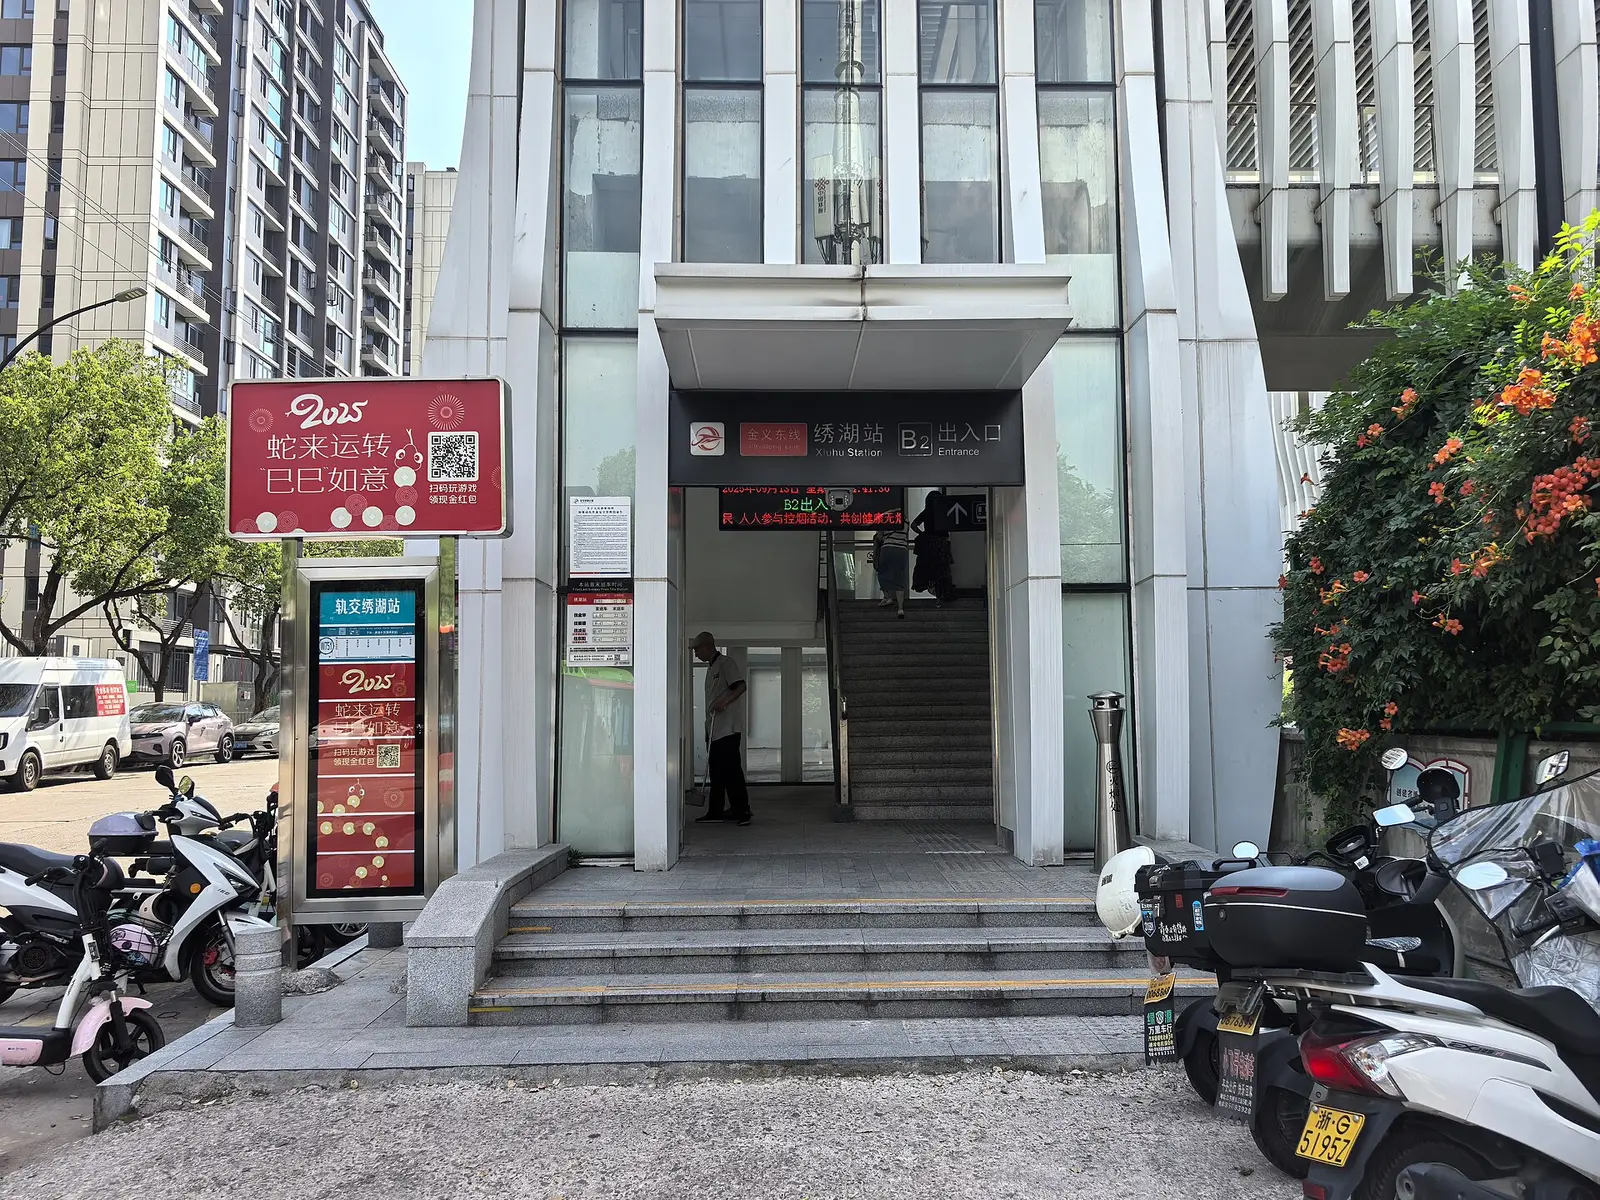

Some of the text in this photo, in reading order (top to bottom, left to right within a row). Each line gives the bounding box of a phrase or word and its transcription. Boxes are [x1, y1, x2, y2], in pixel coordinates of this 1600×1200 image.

[285, 393, 369, 430] 2025
[748, 428, 801, 441] 金义东线
[814, 423, 884, 444] 绣湖站
[901, 429, 930, 449] B2
[938, 423, 1001, 443] 出入口
[266, 433, 392, 460] 蛇来运转
[815, 449, 883, 457] Xiuhu Station
[938, 448, 980, 456] Entrance
[429, 484, 477, 493] 扫码玩游戏
[429, 495, 477, 504] 领现金红包
[723, 513, 733, 525] 民
[335, 598, 400, 615] 轨交绣湖站
[338, 668, 396, 694] 2025
[335, 702, 401, 718] 蛇来运转
[333, 748, 375, 757] 扫码玩游戏
[333, 758, 375, 766] 领现金红包
[1315, 1110, 1351, 1135] 浙·G
